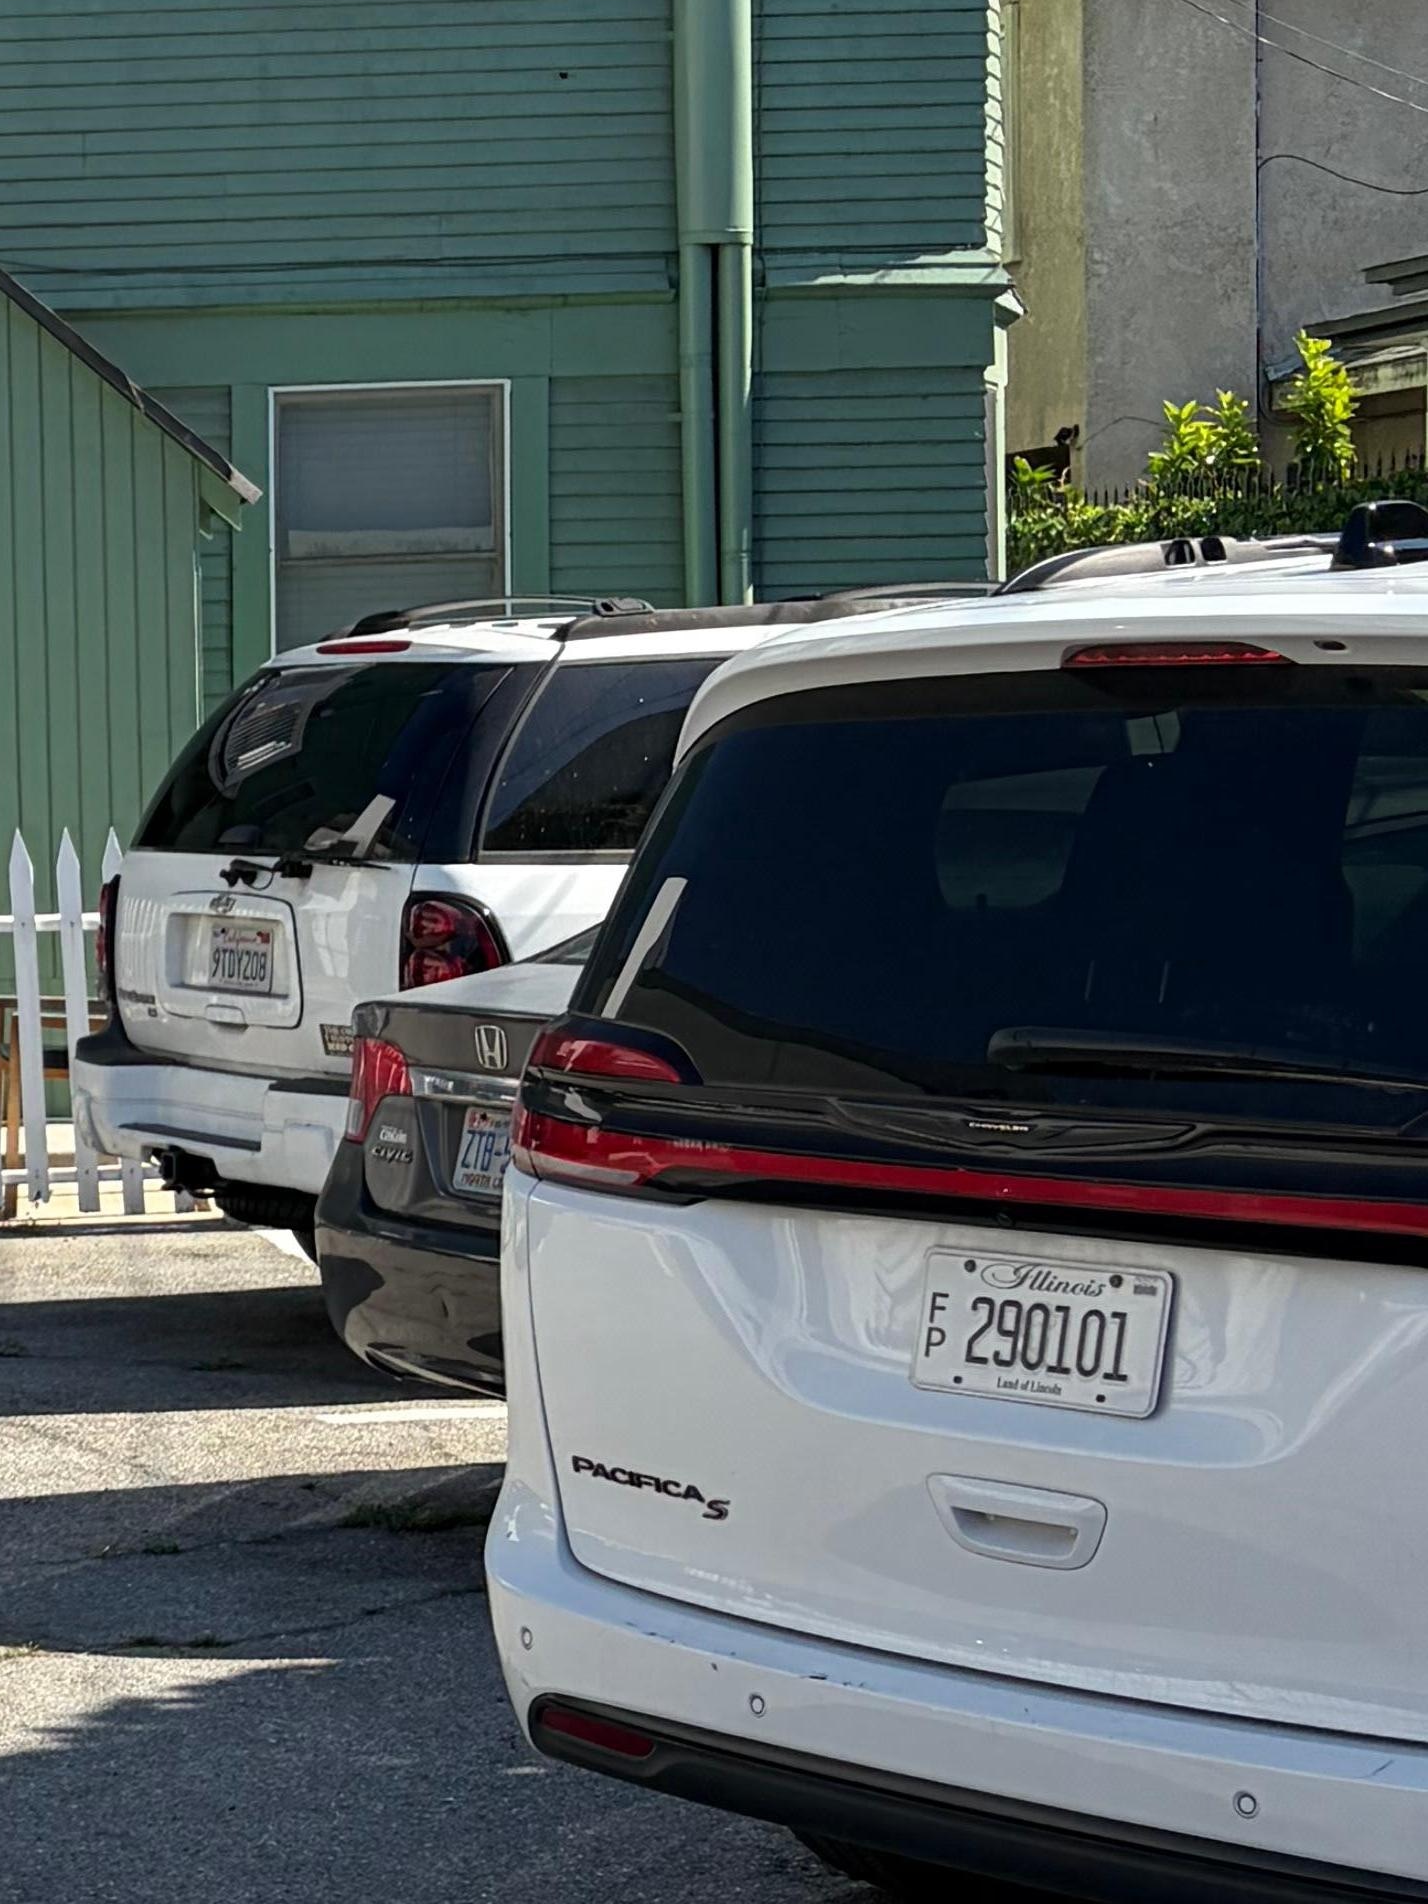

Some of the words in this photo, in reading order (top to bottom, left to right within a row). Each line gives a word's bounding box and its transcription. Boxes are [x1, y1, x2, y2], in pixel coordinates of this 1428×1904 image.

[211, 947, 267, 982] 9TDY208
[371, 1145, 413, 1164] CIVIC
[980, 1263, 1106, 1297] Illinois
[929, 1292, 949, 1324] F
[924, 1326, 946, 1358] P
[965, 1297, 1128, 1382] 290101
[997, 1376, 1019, 1391] Land
[1020, 1380, 1030, 1391] of
[1030, 1380, 1062, 1395] Lincoln
[572, 1455, 706, 1503] PACIFICA
[702, 1499, 731, 1521] S
